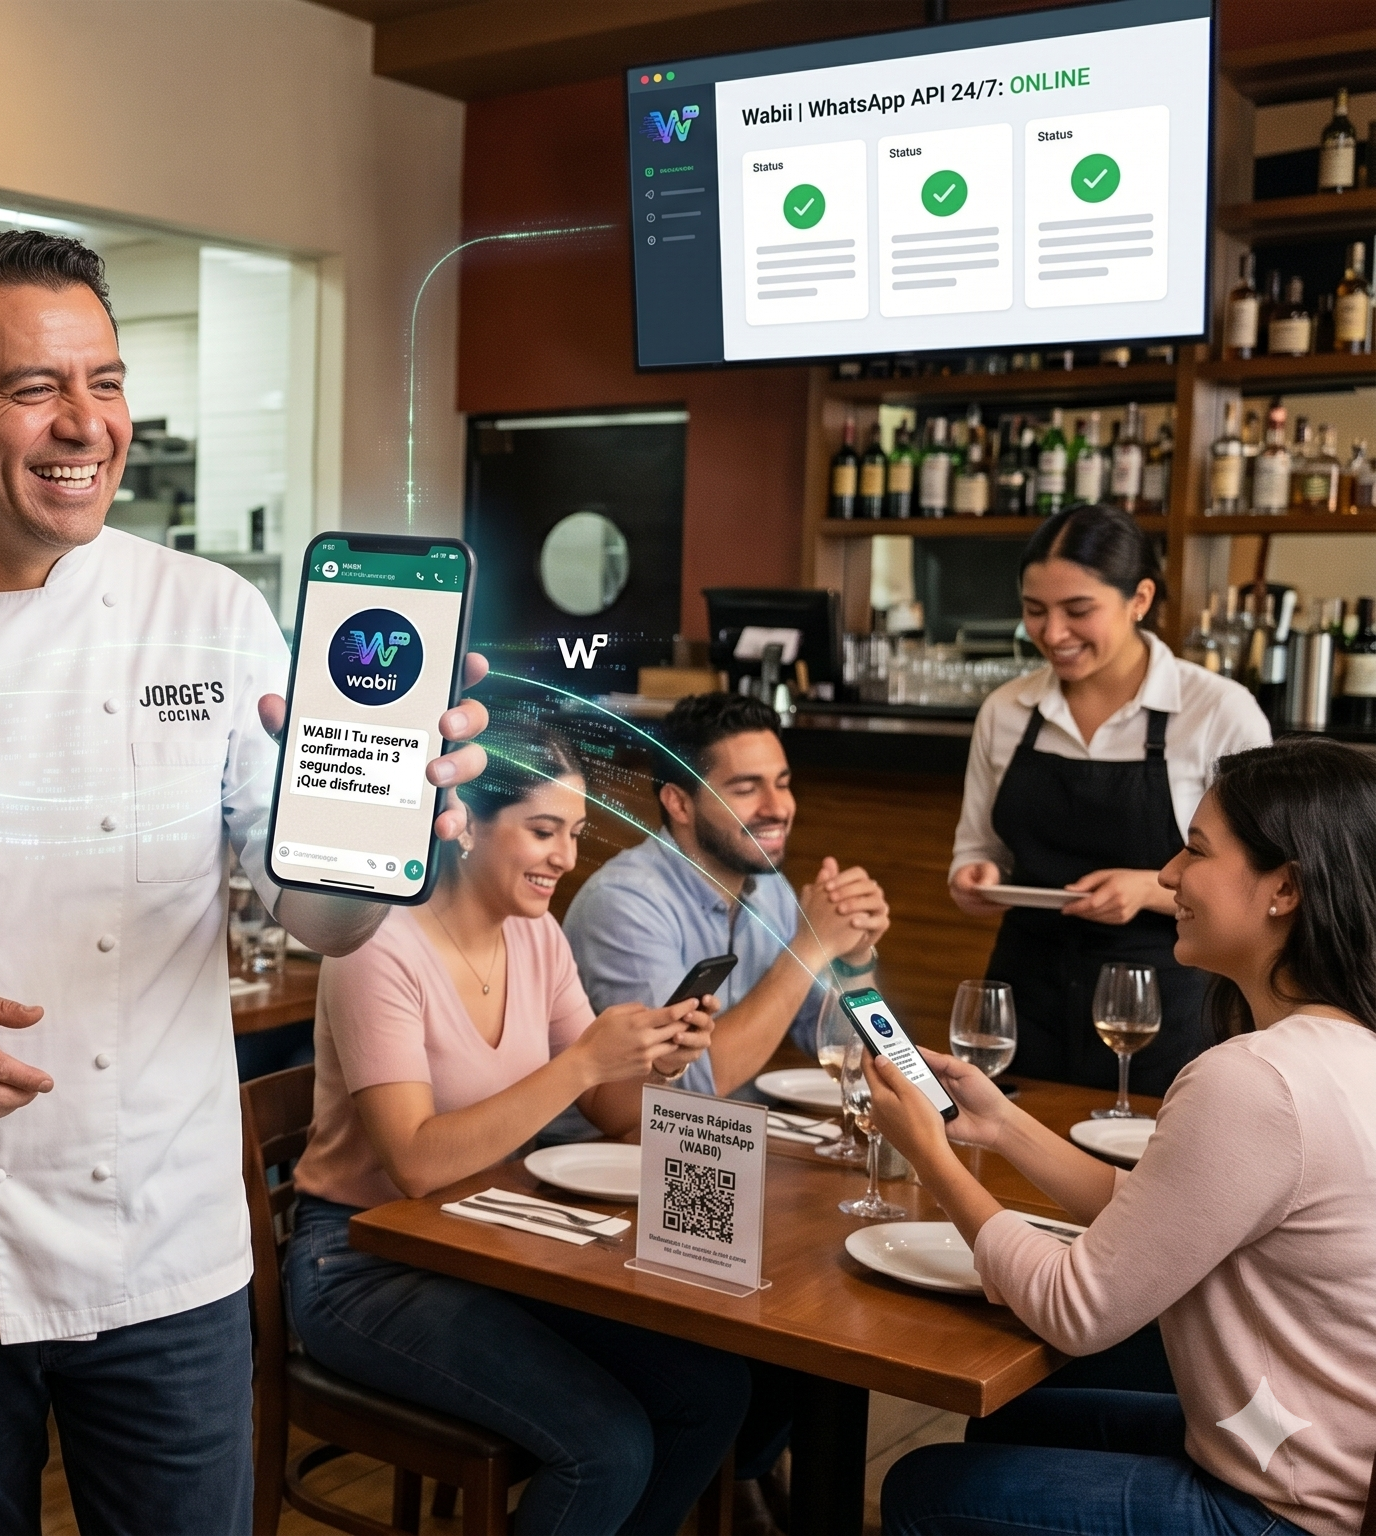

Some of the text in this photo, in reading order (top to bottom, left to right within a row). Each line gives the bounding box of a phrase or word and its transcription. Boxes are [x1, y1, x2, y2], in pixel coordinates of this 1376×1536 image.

[741, 103, 793, 126] Wabii
[808, 93, 906, 118] WhatsApp
[910, 85, 945, 107] API
[951, 78, 1004, 102] 24/7:
[1009, 67, 1091, 95] ONLINE
[1036, 129, 1074, 142] Status
[889, 147, 922, 159] Status
[752, 161, 784, 173] Status
[346, 673, 398, 691] wabii
[139, 681, 225, 707] JORGE'S
[158, 708, 211, 722] COCINA
[303, 724, 342, 740] WABII
[351, 730, 368, 743] Tu
[370, 734, 419, 749] reserva
[301, 743, 400, 763] confirmada in 3
[299, 759, 366, 776] segundos.
[297, 774, 391, 796] ¡Que disfrutes!
[653, 1104, 752, 1134] Reservas Rápidas
[649, 1119, 755, 1152] 24/7 via WhatsApp
